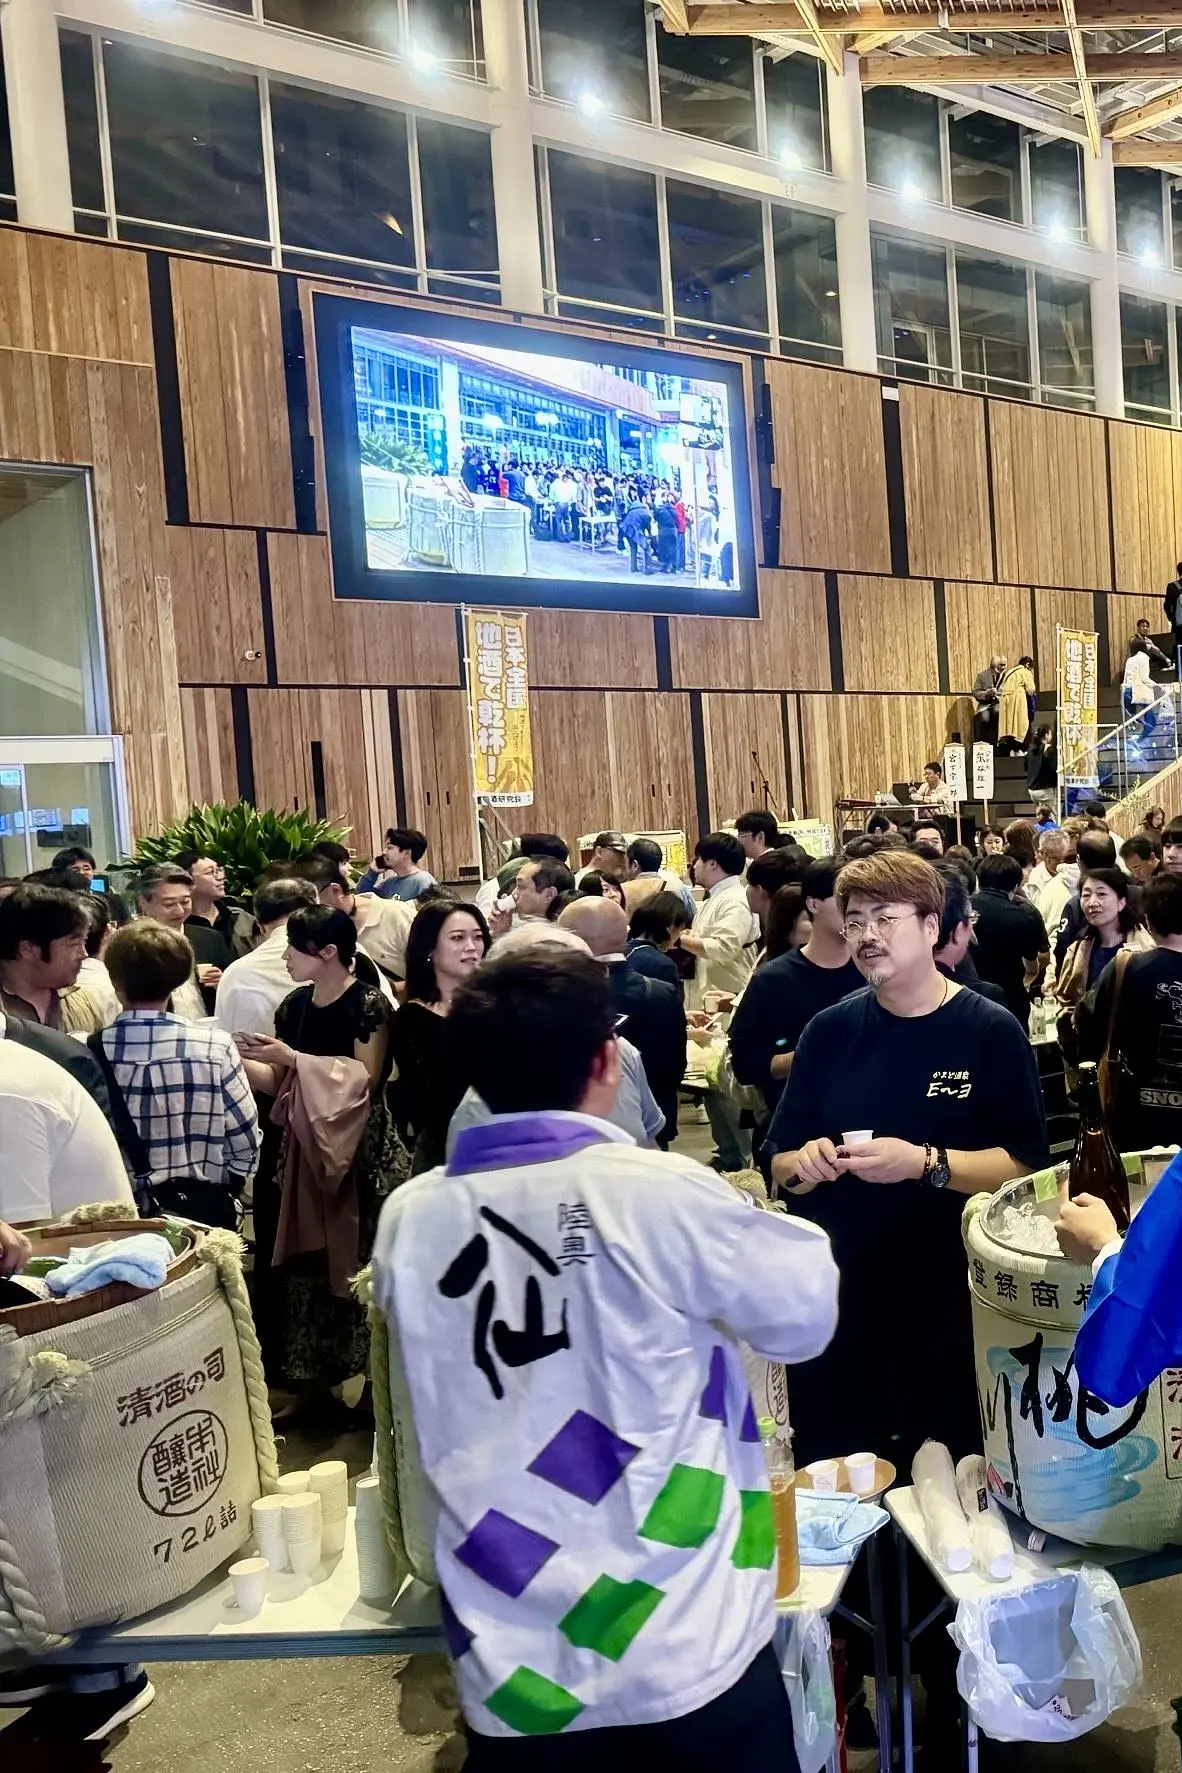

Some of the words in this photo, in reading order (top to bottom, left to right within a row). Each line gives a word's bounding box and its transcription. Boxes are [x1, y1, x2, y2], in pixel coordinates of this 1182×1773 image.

[504, 626, 527, 710] 日本全国
[1083, 642, 1096, 710] 日本全国
[556, 1202, 598, 1267] 陸奥
[117, 1346, 225, 1427] 清酒の司
